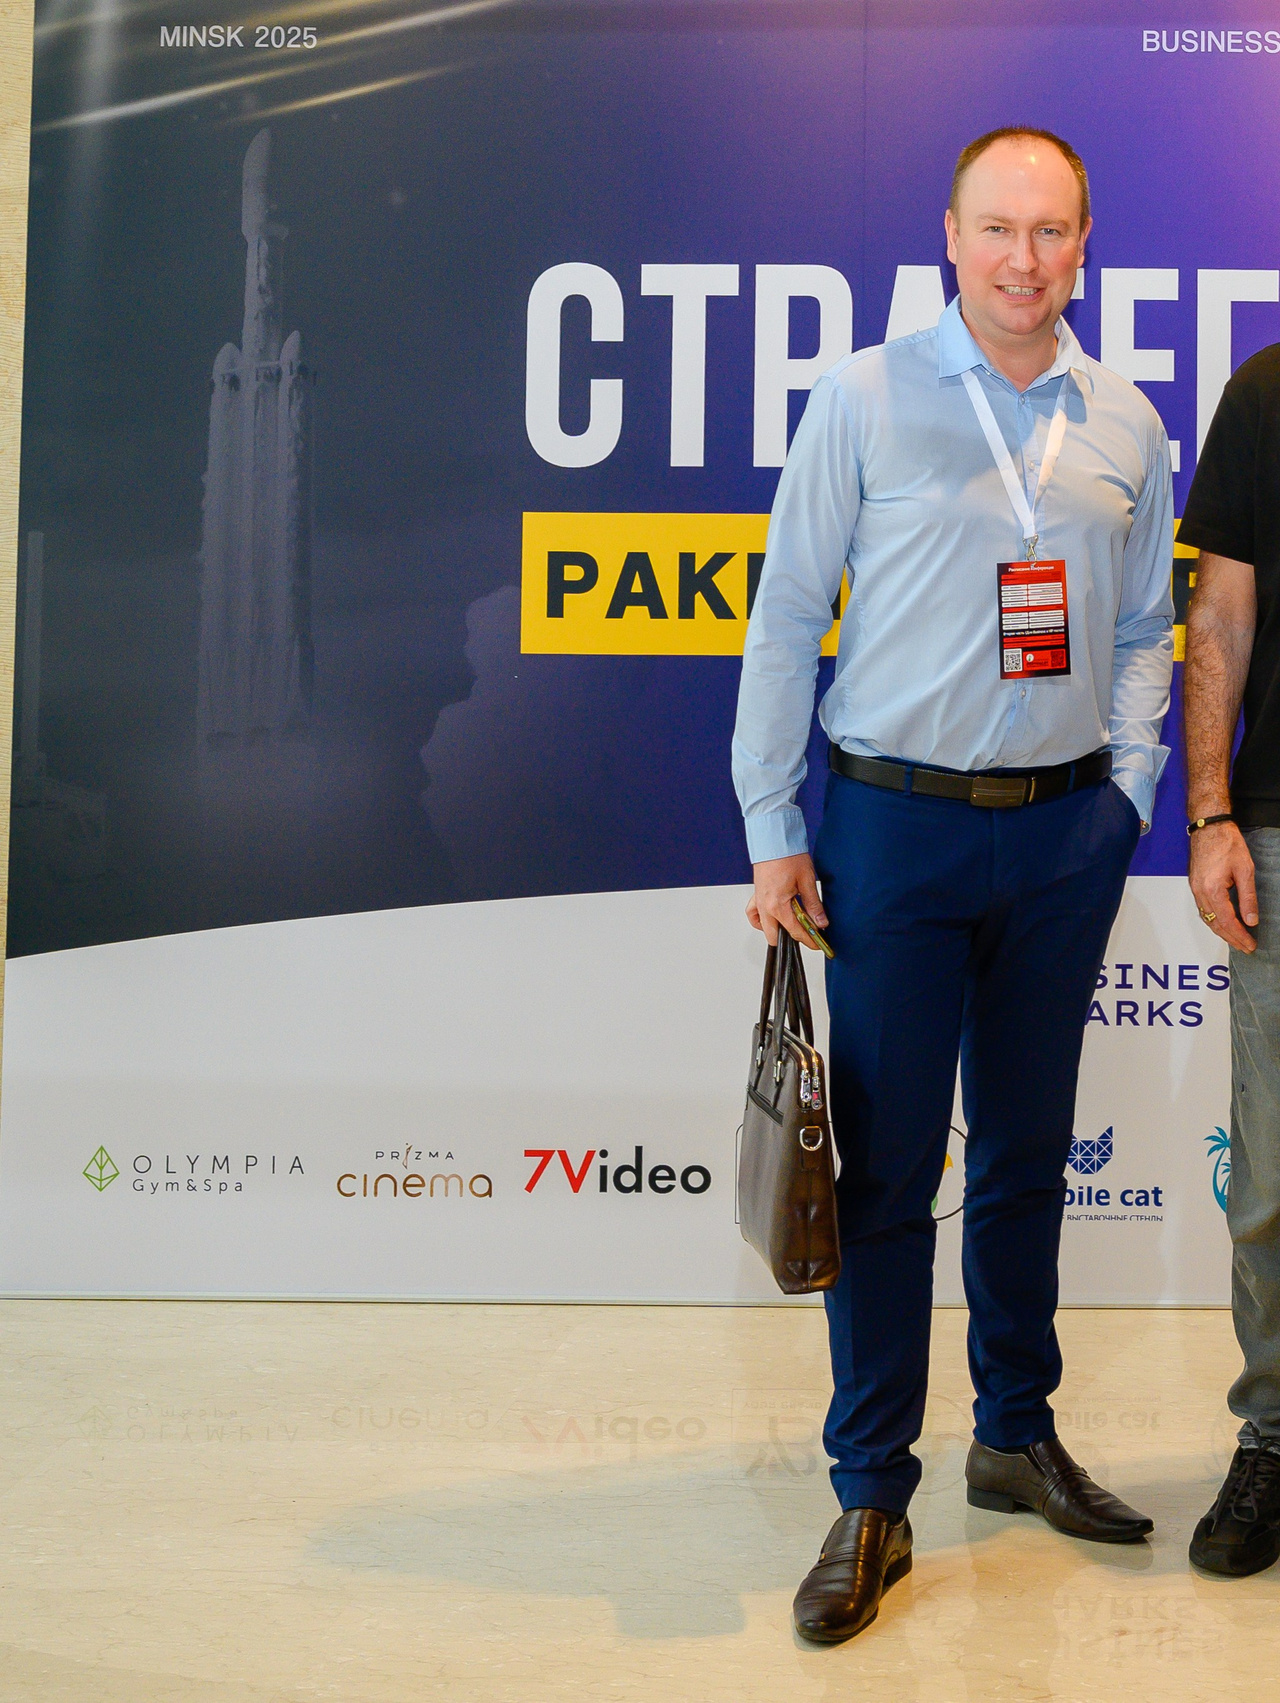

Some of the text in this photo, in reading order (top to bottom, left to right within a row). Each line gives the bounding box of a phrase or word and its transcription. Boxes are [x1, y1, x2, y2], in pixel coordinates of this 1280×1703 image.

[160, 25, 317, 49] MINSK 2025
[1142, 30, 1280, 54] BUSINESS
[1085, 1000, 1204, 1027] ARKS
[132, 1154, 304, 1175] OLYMPIA
[523, 1145, 712, 1194] 7Video
[132, 1178, 243, 1194] Gym&Spa
[336, 1173, 493, 1198] cinema
[1119, 1186, 1163, 1207] cat
